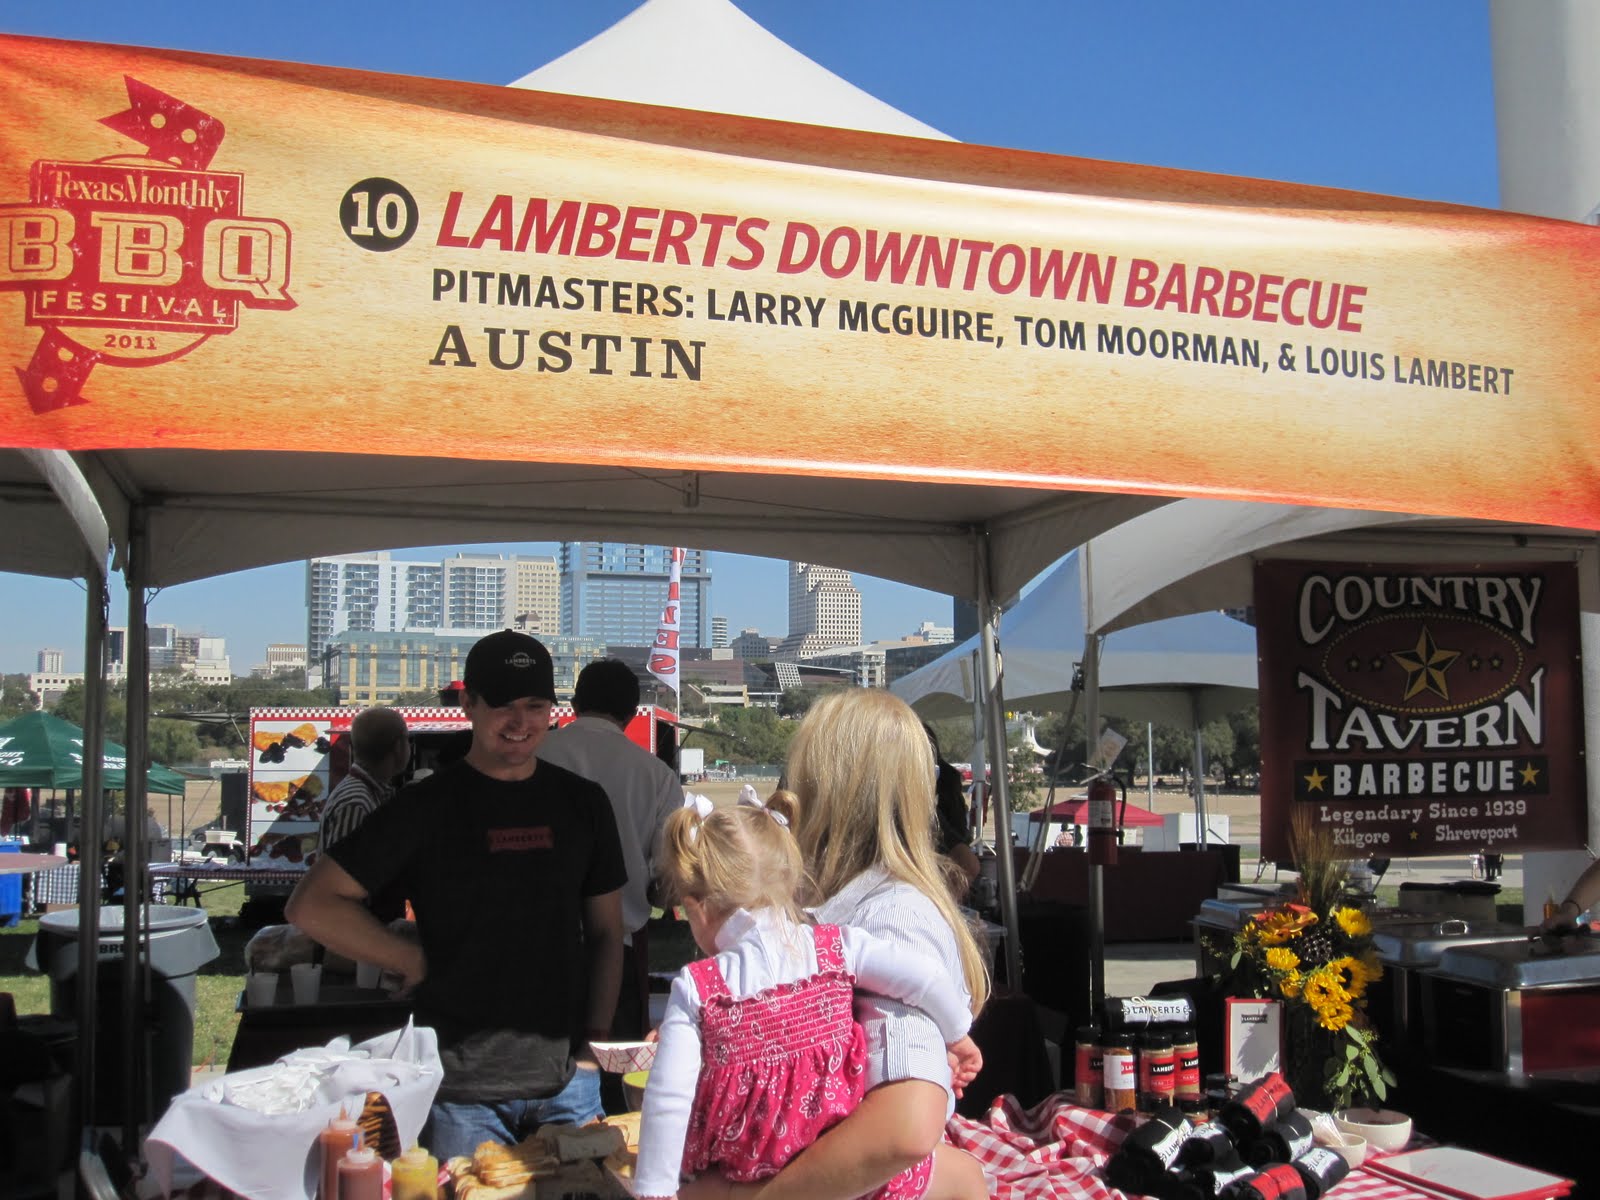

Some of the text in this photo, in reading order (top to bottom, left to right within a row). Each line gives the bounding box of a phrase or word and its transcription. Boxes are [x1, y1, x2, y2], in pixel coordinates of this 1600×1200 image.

[0, 207, 294, 305] BBQ
[350, 190, 1368, 333] 10 LAMBERTS DOWNTOWN BARBECUE
[42, 291, 227, 319] FESTIVAL
[432, 268, 1514, 396] PITMASTERS: LARRY MCGUIRE, TOM MOORMAN, & LOUIS LAMBERT
[104, 334, 158, 351] 2011
[428, 324, 706, 381] AUSTIN
[1299, 575, 1542, 645] COUNTRY
[1298, 667, 1544, 750] TAVERN
[1333, 759, 1514, 796] BARBECUE
[1320, 800, 1527, 825] Legendary Since 1939
[1333, 824, 1518, 848] Kilgore Shreveport
